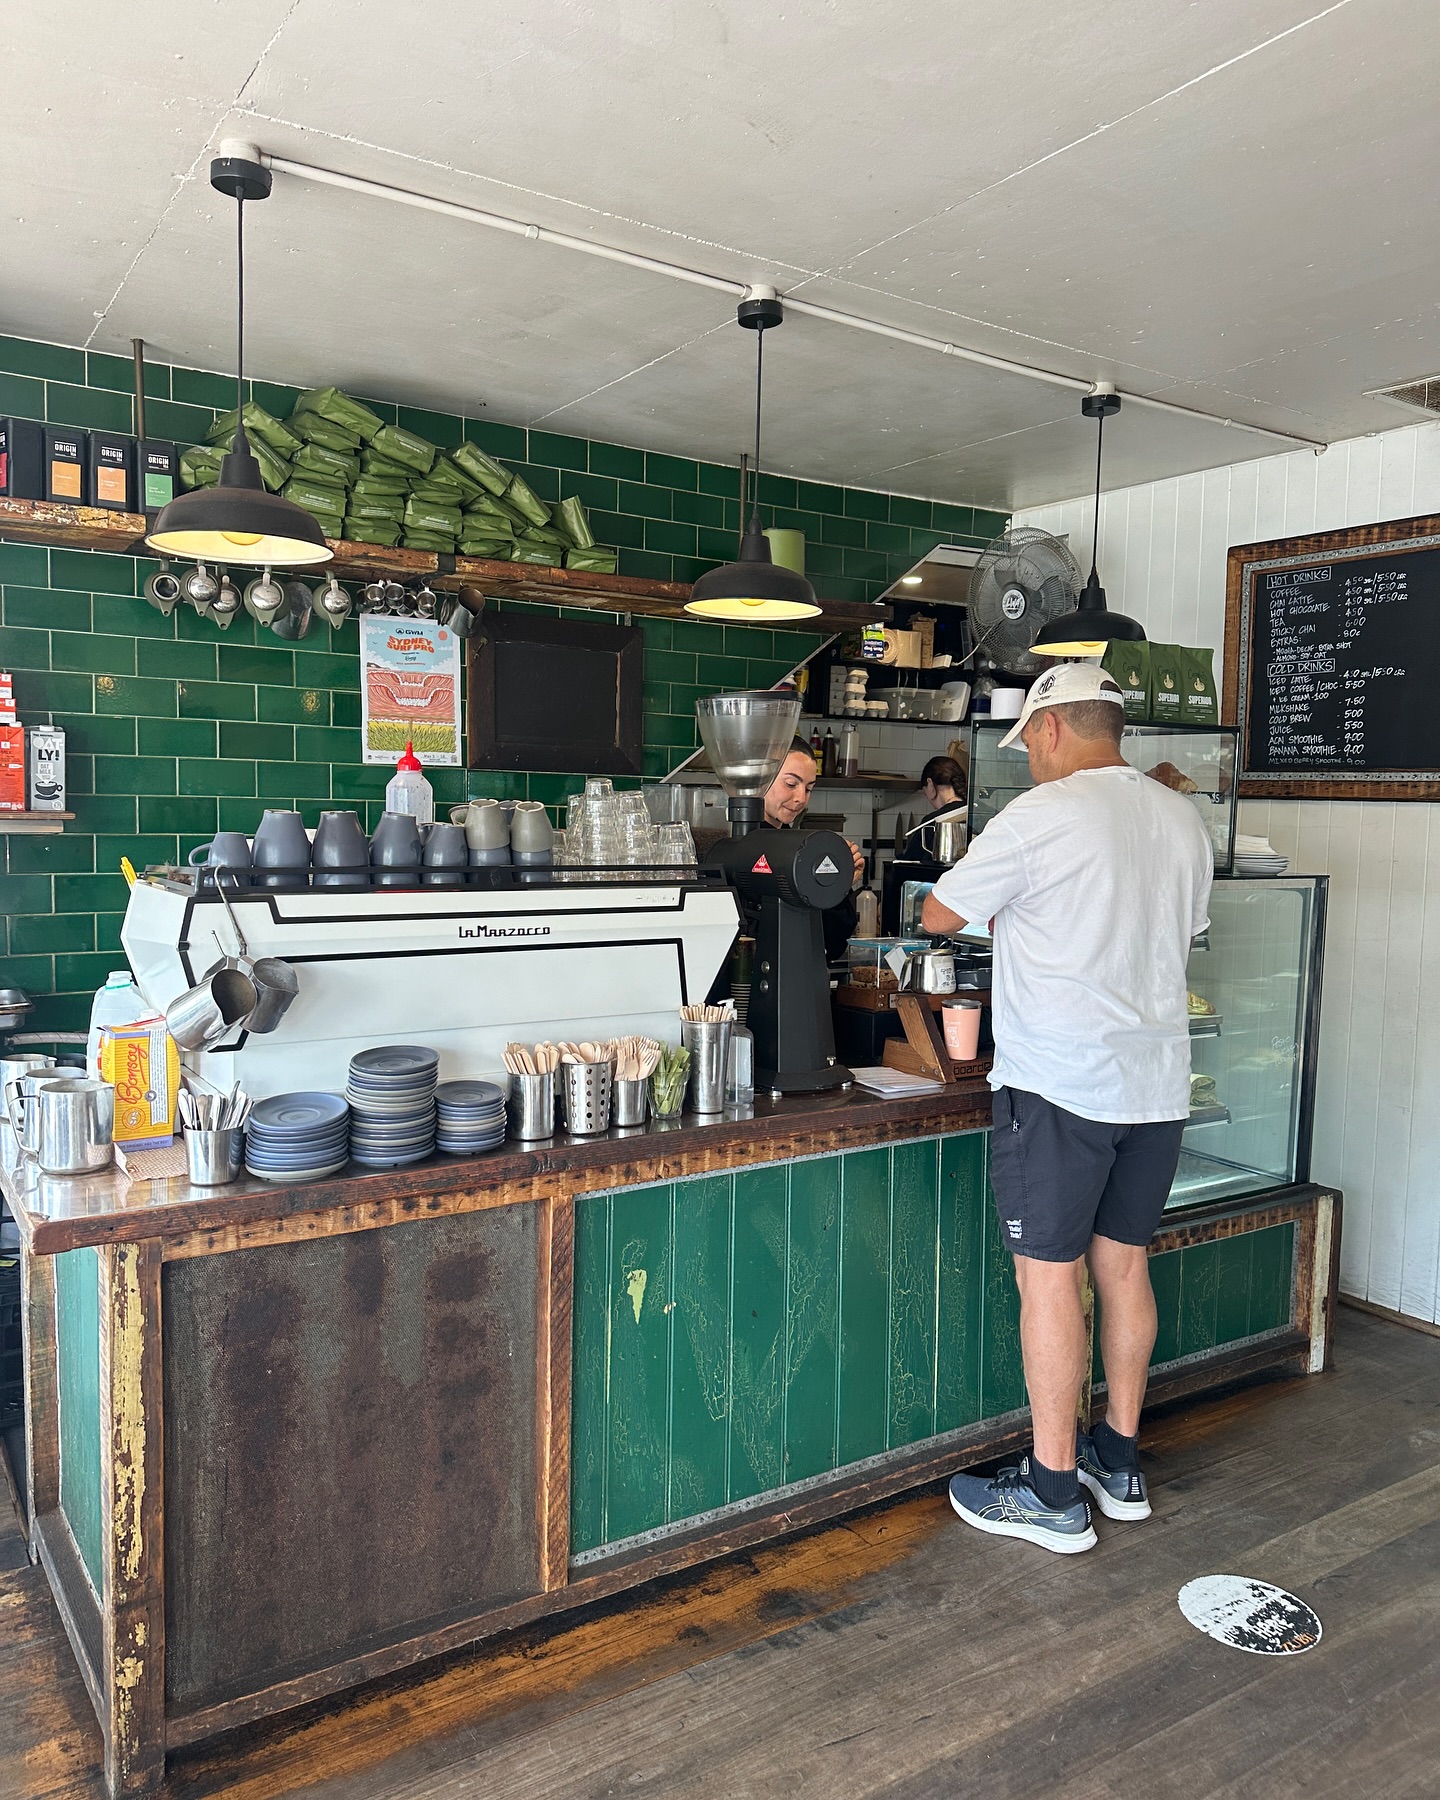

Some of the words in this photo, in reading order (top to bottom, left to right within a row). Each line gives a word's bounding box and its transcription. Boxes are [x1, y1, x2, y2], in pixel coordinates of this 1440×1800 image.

[55, 444, 76, 452] ORIGIN
[101, 449, 122, 458] ORIGIN
[148, 456, 169, 464] ORIGIN
[1271, 575, 1287, 587] HOT
[1293, 570, 1329, 581] DRINKS
[1271, 587, 1301, 599] COFFEE
[1270, 598, 1285, 609] CHAI
[1288, 594, 1314, 605] LATTE
[1270, 608, 1285, 618] HOT
[1290, 602, 1330, 614] CHOCOLATE
[1270, 618, 1285, 628] TEA
[1271, 625, 1296, 637] STICKY
[1299, 624, 1316, 634] CHAI
[388, 636, 433, 646] SYDNEY
[1336, 641, 1352, 650] SHOT
[386, 642, 412, 651] SURF
[414, 644, 435, 654] PRO
[1314, 651, 1327, 659] OAT
[1269, 665, 1295, 676] COLD
[1298, 661, 1333, 672] DRINKS
[1269, 677, 1286, 685] ICED
[1290, 675, 1312, 684] LATTE
[1269, 686, 1286, 695] ICED
[1158, 692, 1180, 703] SUPERIOR
[1188, 695, 1212, 705] SUPERIOR
[1291, 694, 1310, 702] CREAM
[1269, 703, 1310, 714] MILKSHAKE
[1269, 716, 1287, 724] COLD
[1290, 713, 1312, 723] BREW
[1269, 725, 1293, 735] JUICE
[33, 737, 63, 749] OAT
[1289, 734, 1324, 744] SMOOTHIE
[38, 749, 59, 760] LY!
[1269, 746, 1299, 756] BANANA
[1302, 745, 1337, 756] SMOOTHIE
